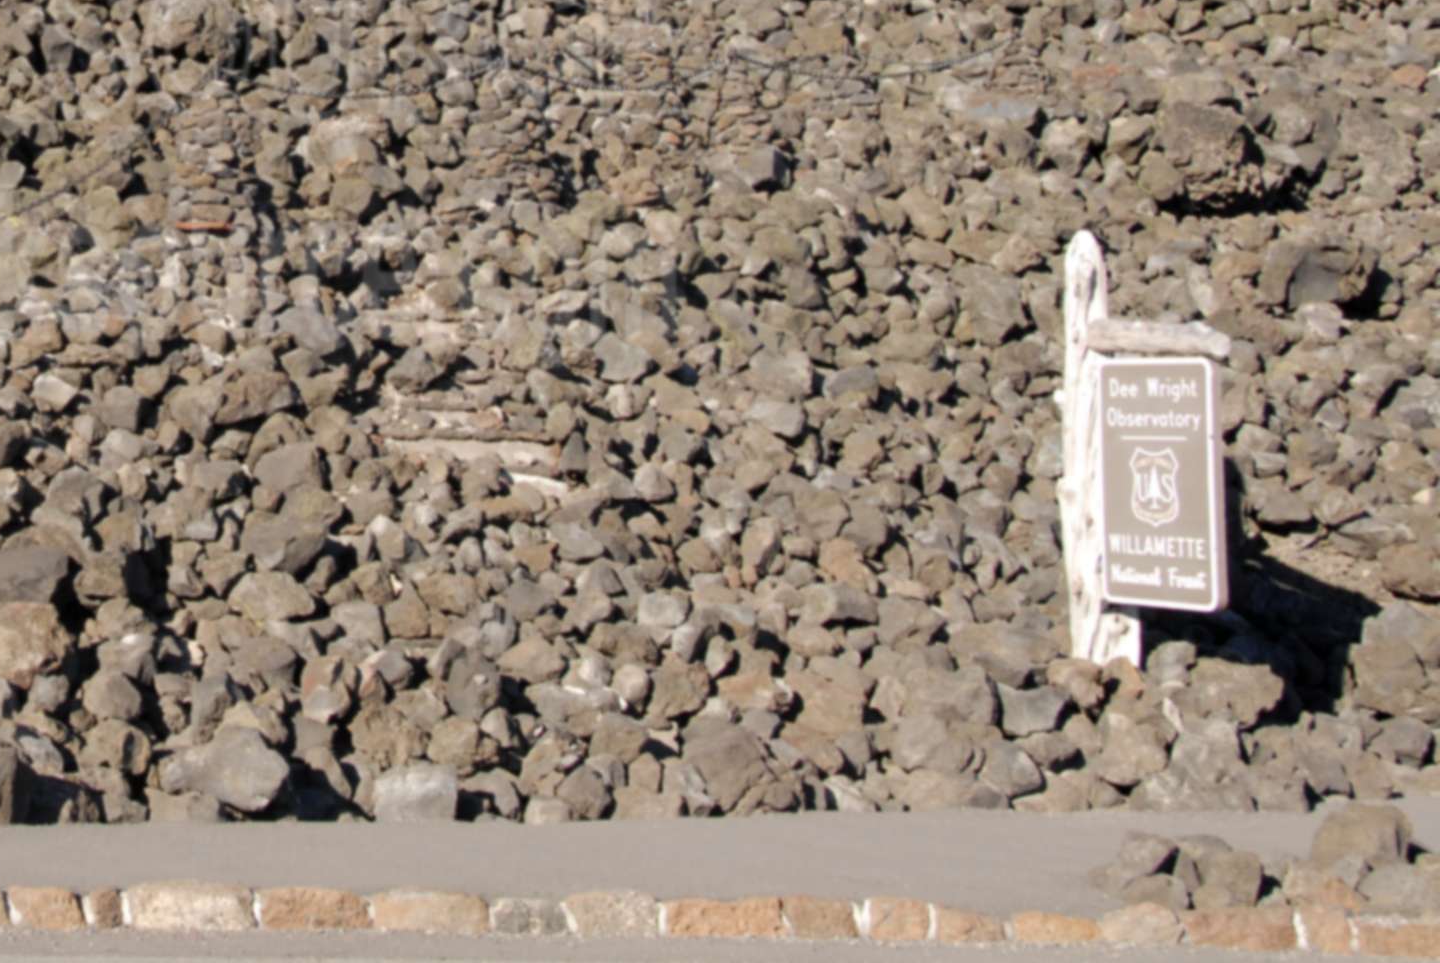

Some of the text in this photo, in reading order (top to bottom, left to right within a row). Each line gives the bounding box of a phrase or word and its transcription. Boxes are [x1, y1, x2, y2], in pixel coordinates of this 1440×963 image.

[1108, 377, 1199, 403] Dee Wright
[1106, 407, 1202, 431] Observatory
[1108, 534, 1206, 560] WILLAMETTE
